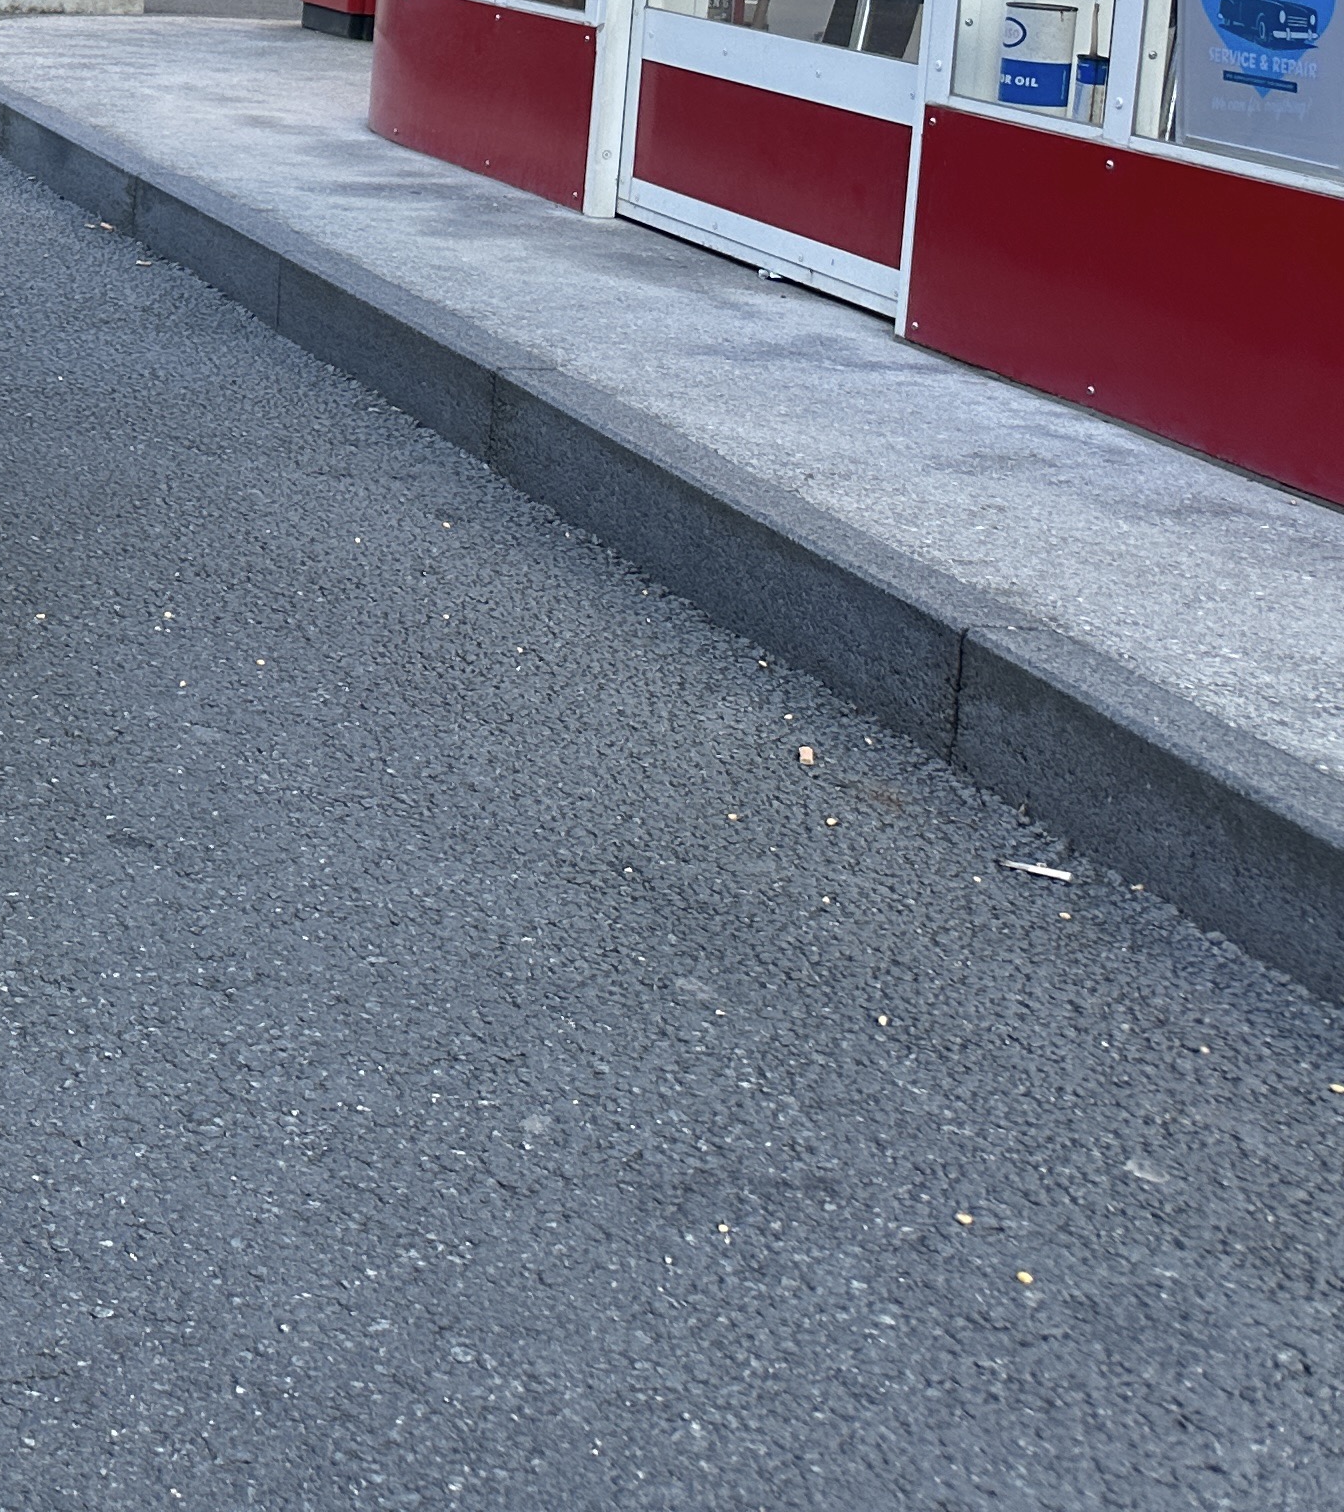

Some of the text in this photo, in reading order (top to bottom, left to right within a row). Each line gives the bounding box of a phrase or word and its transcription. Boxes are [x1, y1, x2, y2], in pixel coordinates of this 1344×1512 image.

[1208, 46, 1317, 79] SERVICE & REPAIR
[1014, 75, 1039, 88] OIL
